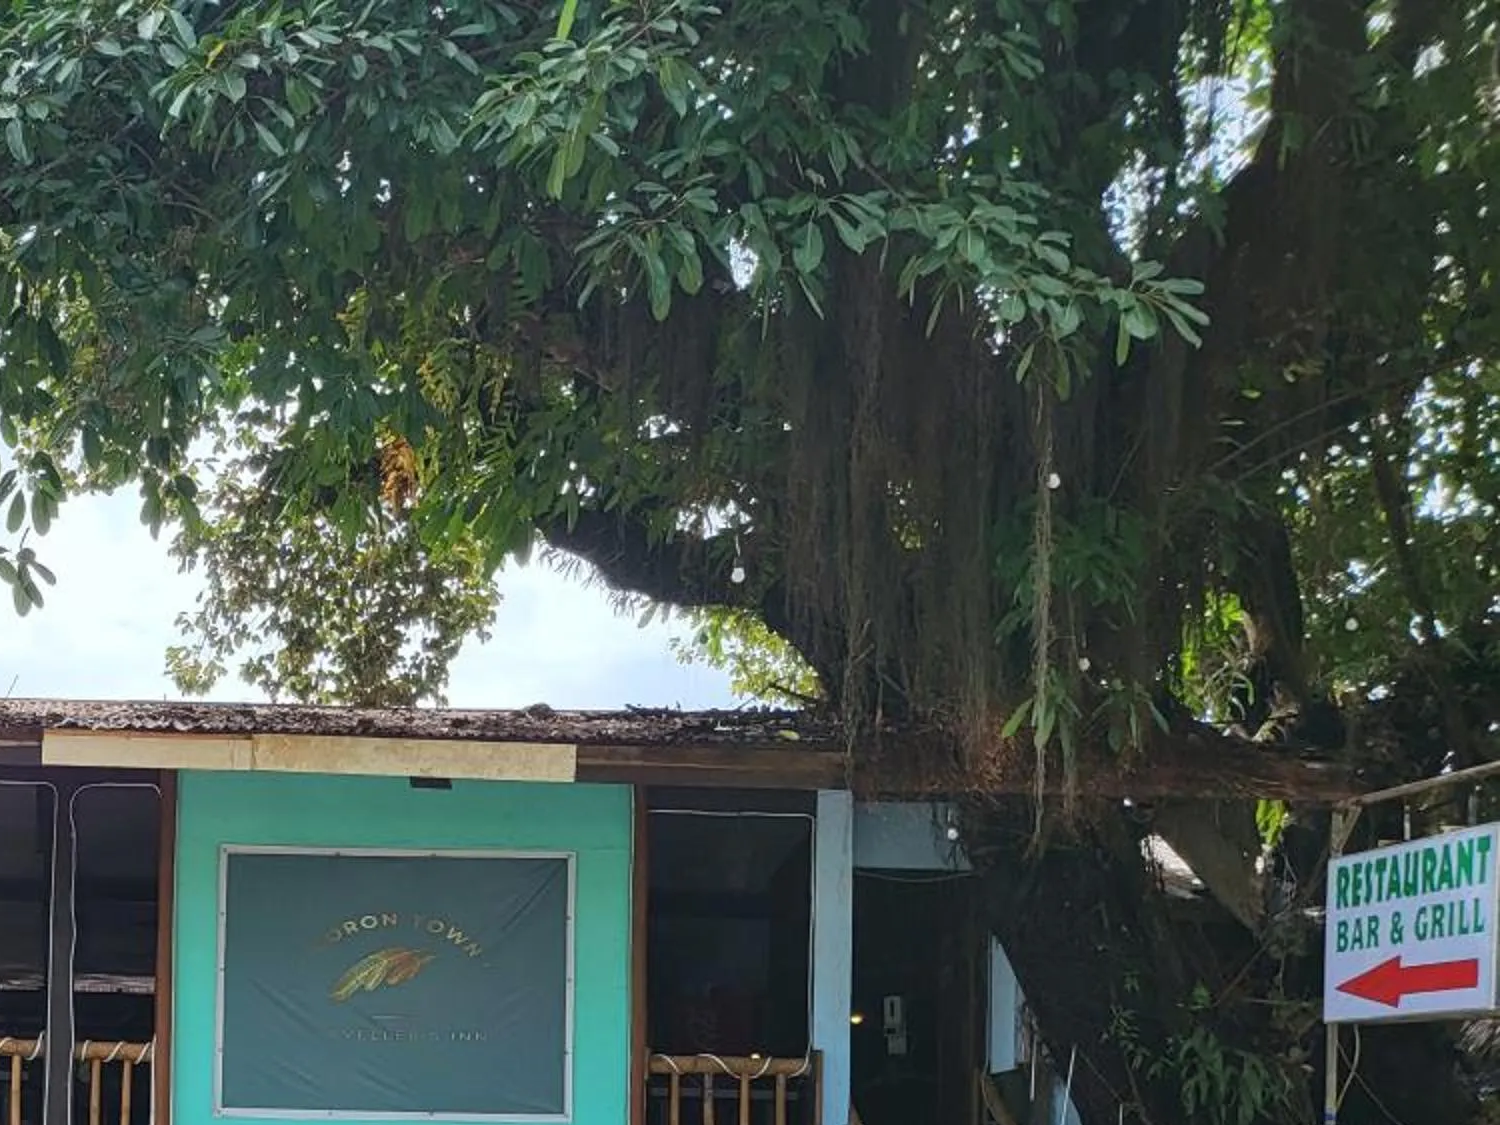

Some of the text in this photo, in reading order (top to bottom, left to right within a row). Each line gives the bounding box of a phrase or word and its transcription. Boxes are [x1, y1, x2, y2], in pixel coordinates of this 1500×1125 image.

[1336, 835, 1492, 909] RESTAURANT
[313, 912, 483, 957] ORON TOWN
[1336, 898, 1485, 953] BAR & GRILL
